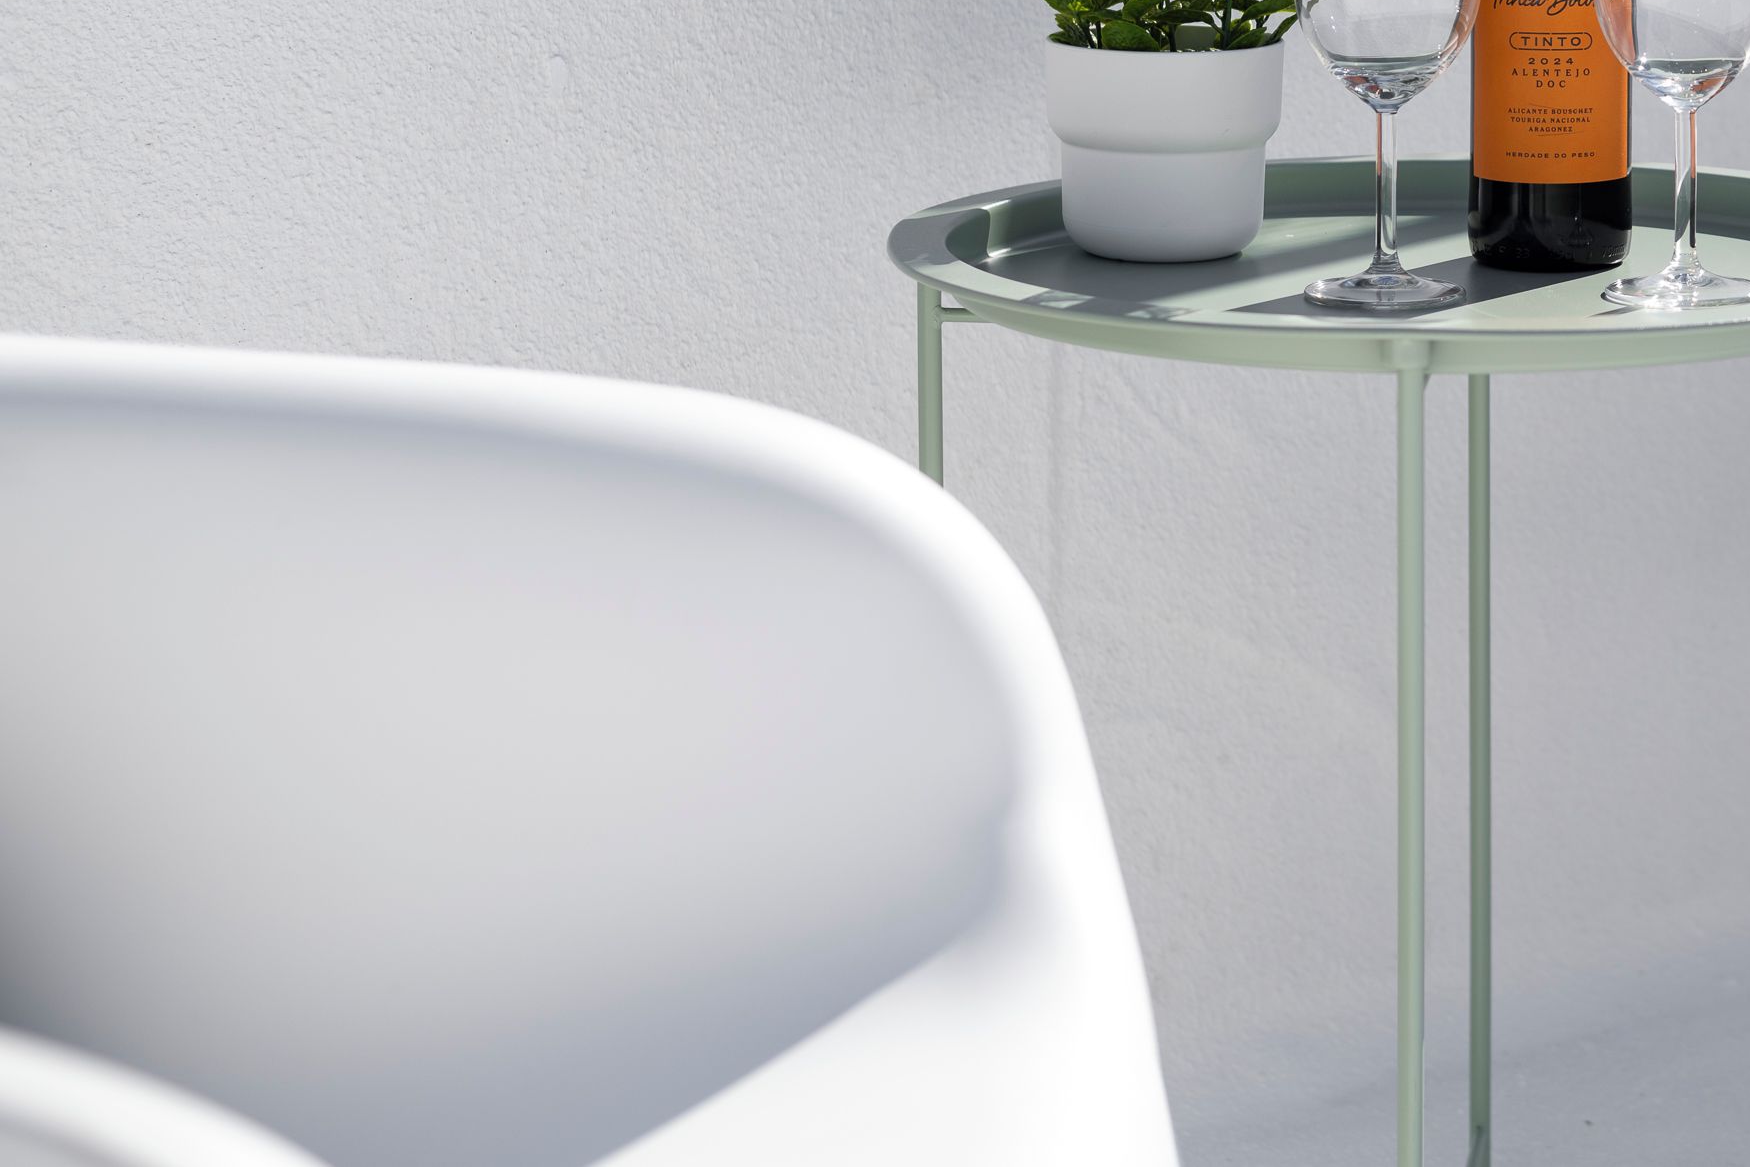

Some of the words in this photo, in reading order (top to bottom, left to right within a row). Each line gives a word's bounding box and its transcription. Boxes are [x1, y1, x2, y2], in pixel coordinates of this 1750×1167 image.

[1520, 36, 1582, 47] TINTO
[1528, 57, 1574, 65] 2024
[1511, 67, 1591, 77] ALENTEJO
[1536, 79, 1567, 88] DOC
[1507, 107, 1548, 115] ALICANTE
[1551, 107, 1593, 115] BOUSCHET
[1510, 116, 1547, 124] TOURIGA
[1505, 151, 1549, 159] HERDADE
[1571, 151, 1596, 159] PESO
